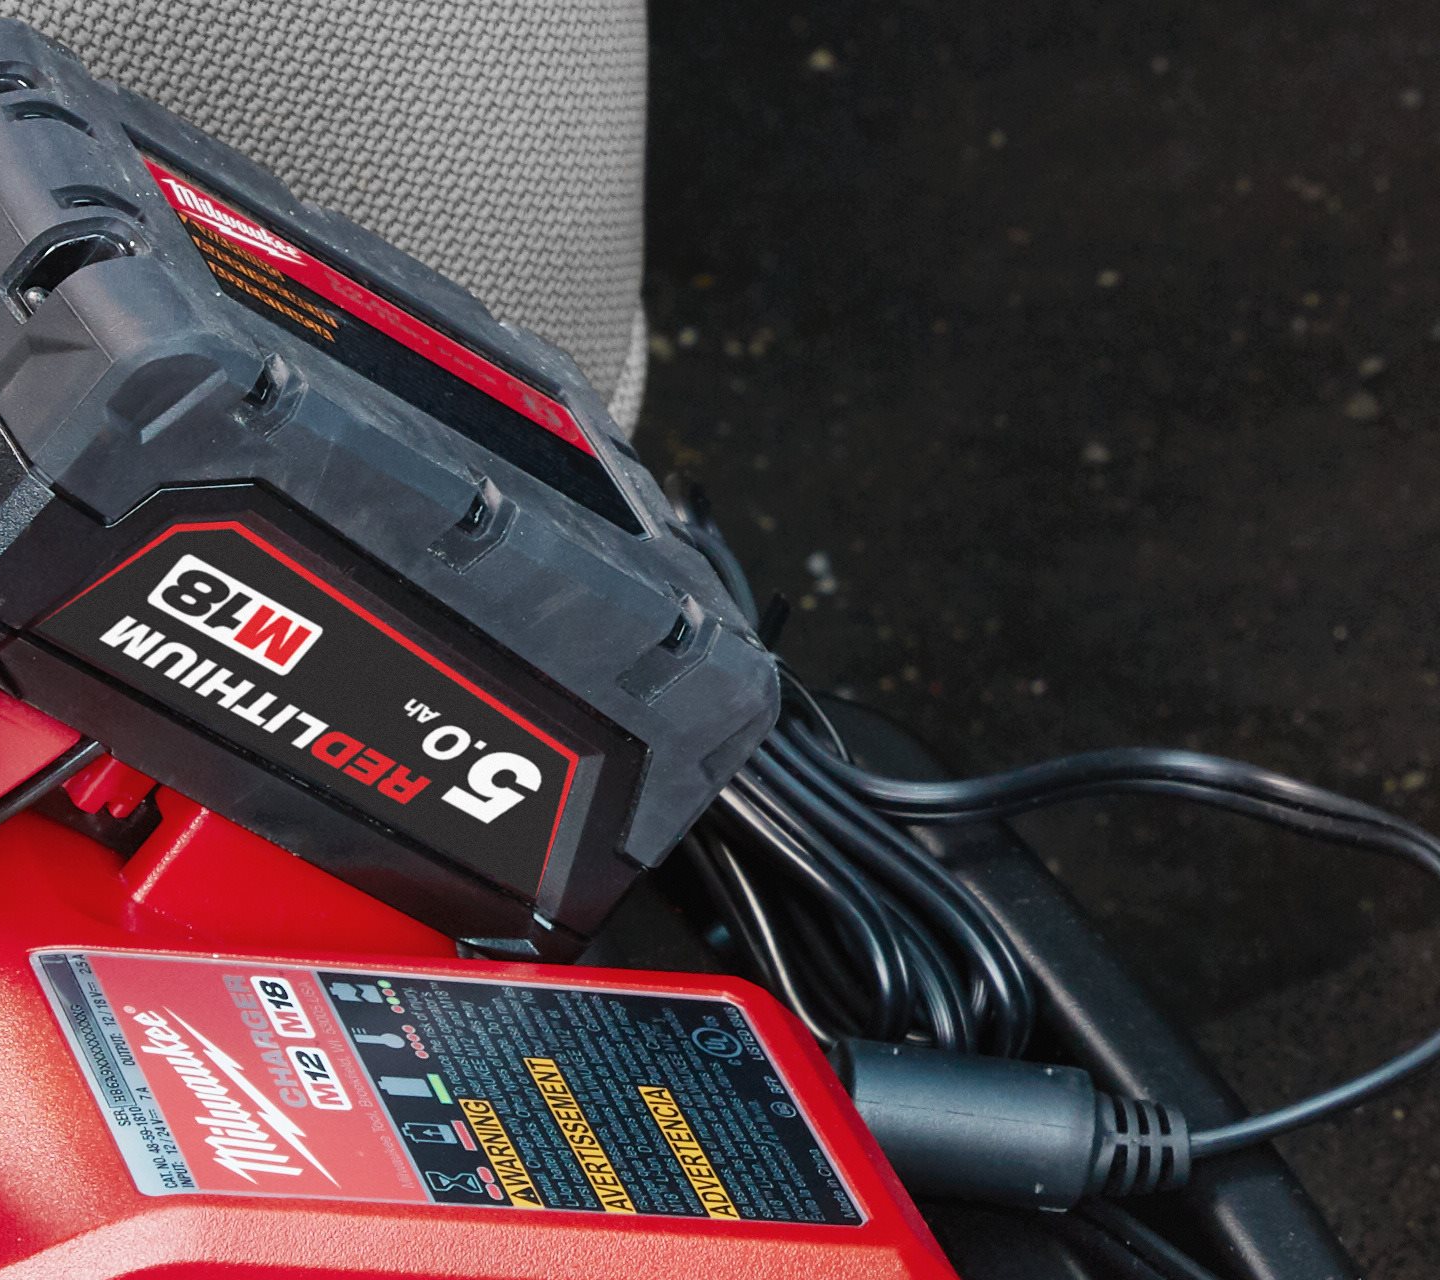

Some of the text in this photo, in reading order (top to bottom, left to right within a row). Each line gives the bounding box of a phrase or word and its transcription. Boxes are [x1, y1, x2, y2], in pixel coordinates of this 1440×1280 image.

[162, 178, 303, 261] Milwaukee
[162, 569, 312, 667] M18
[99, 615, 432, 805] REDLITHIUM
[403, 698, 542, 824] 5.0 Ah
[93, 998, 108, 1008] 18
[478, 1006, 494, 1019] not
[101, 1016, 116, 1025] 12
[411, 1011, 428, 1020] of
[448, 1010, 465, 1026] and
[501, 1015, 513, 1023] to
[421, 1022, 436, 1037] risk
[487, 1021, 503, 1034] Do
[109, 1033, 135, 1065] OUTPUT:
[224, 975, 306, 1106] CHARGER
[260, 980, 341, 1104] M12 M18
[429, 1039, 445, 1052] the
[441, 1034, 462, 1054] read
[438, 1054, 461, 1084] reduce
[454, 1055, 473, 1076] must
[486, 1057, 503, 1066] of
[467, 1078, 486, 1097] user
[470, 1059, 510, 1113] MILWAUKEE
[496, 1068, 518, 1091] types
[516, 1074, 529, 1084] or
[452, 1086, 466, 1096] To
[113, 1107, 131, 1126] SER.
[510, 1093, 530, 1117] Other
[154, 1126, 169, 1136] 24
[505, 1116, 522, 1134] only
[528, 1060, 630, 1209] AVERTISSEMENT
[534, 1110, 567, 1147] personal
[128, 1106, 178, 1188] CAT. NO. 48-59-1810
[163, 1144, 177, 1153] 12
[464, 1101, 528, 1185] WARNING
[516, 1136, 541, 1168] Charge
[645, 1089, 734, 1216] ADVERTENCIA
[380, 1135, 413, 1188] Milwaukee
[540, 1149, 564, 1179] battery
[557, 1149, 583, 1183] causing
[171, 1161, 194, 1187] INPUT:
[809, 1148, 855, 1217] Made in China
[575, 1185, 597, 1207] burst
